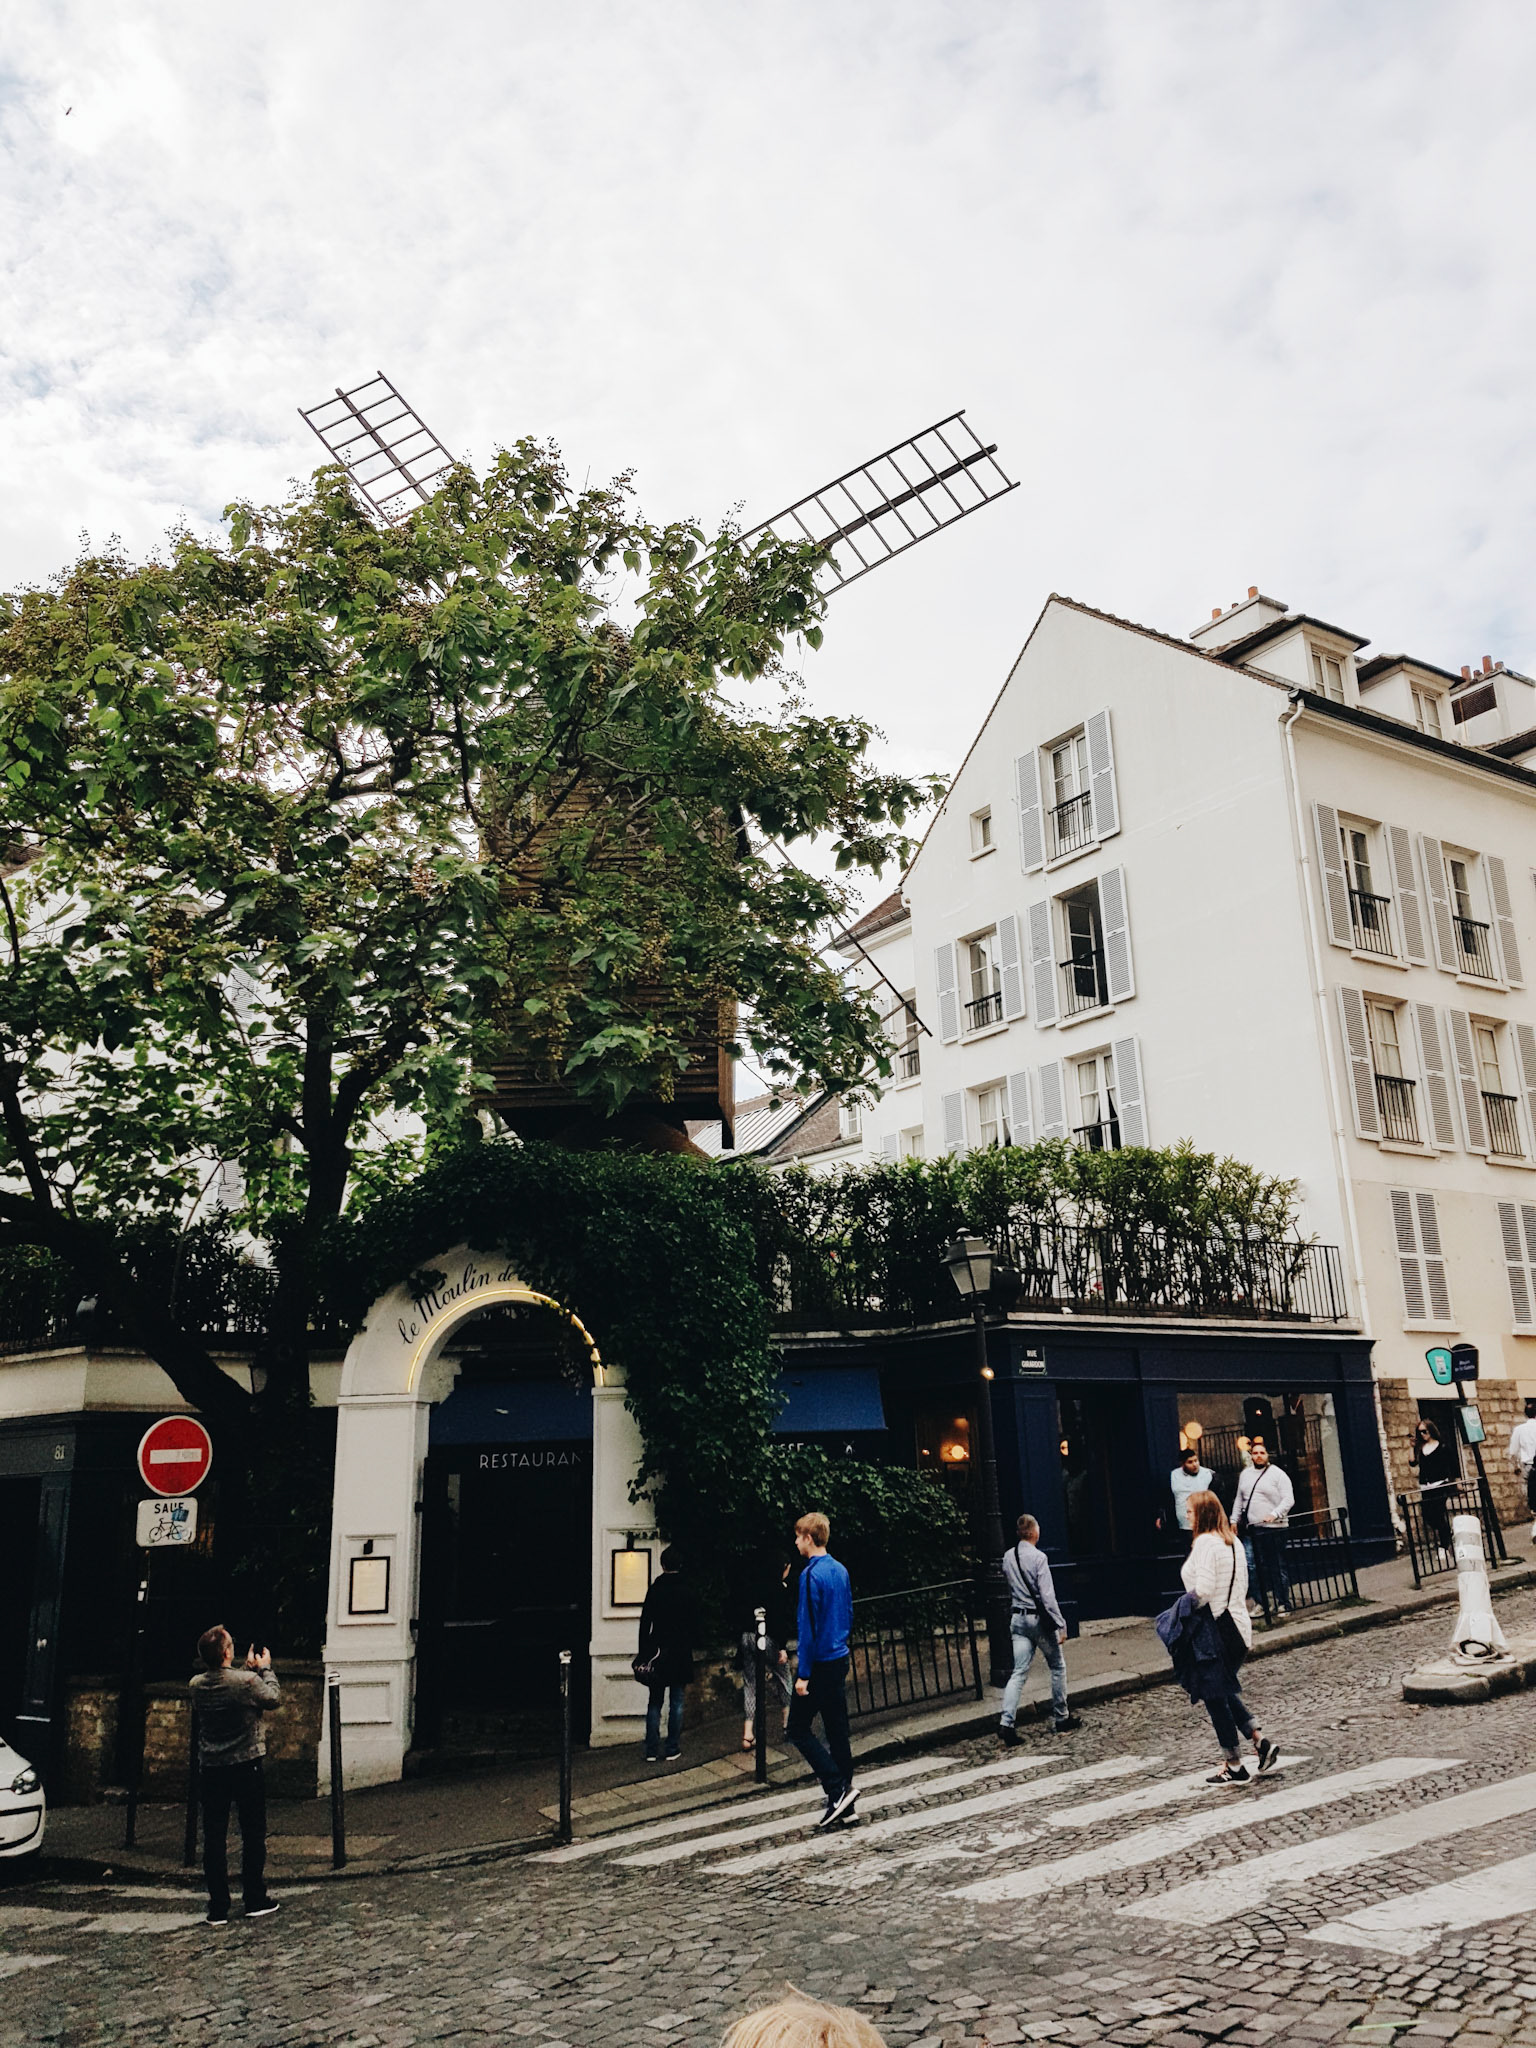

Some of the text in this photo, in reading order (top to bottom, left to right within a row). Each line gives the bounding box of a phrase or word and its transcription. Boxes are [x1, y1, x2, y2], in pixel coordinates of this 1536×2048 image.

[398, 1263, 516, 1344] le Moulin de
[1026, 1349, 1038, 1358] RUE
[479, 1451, 583, 1469] RESTAURAN
